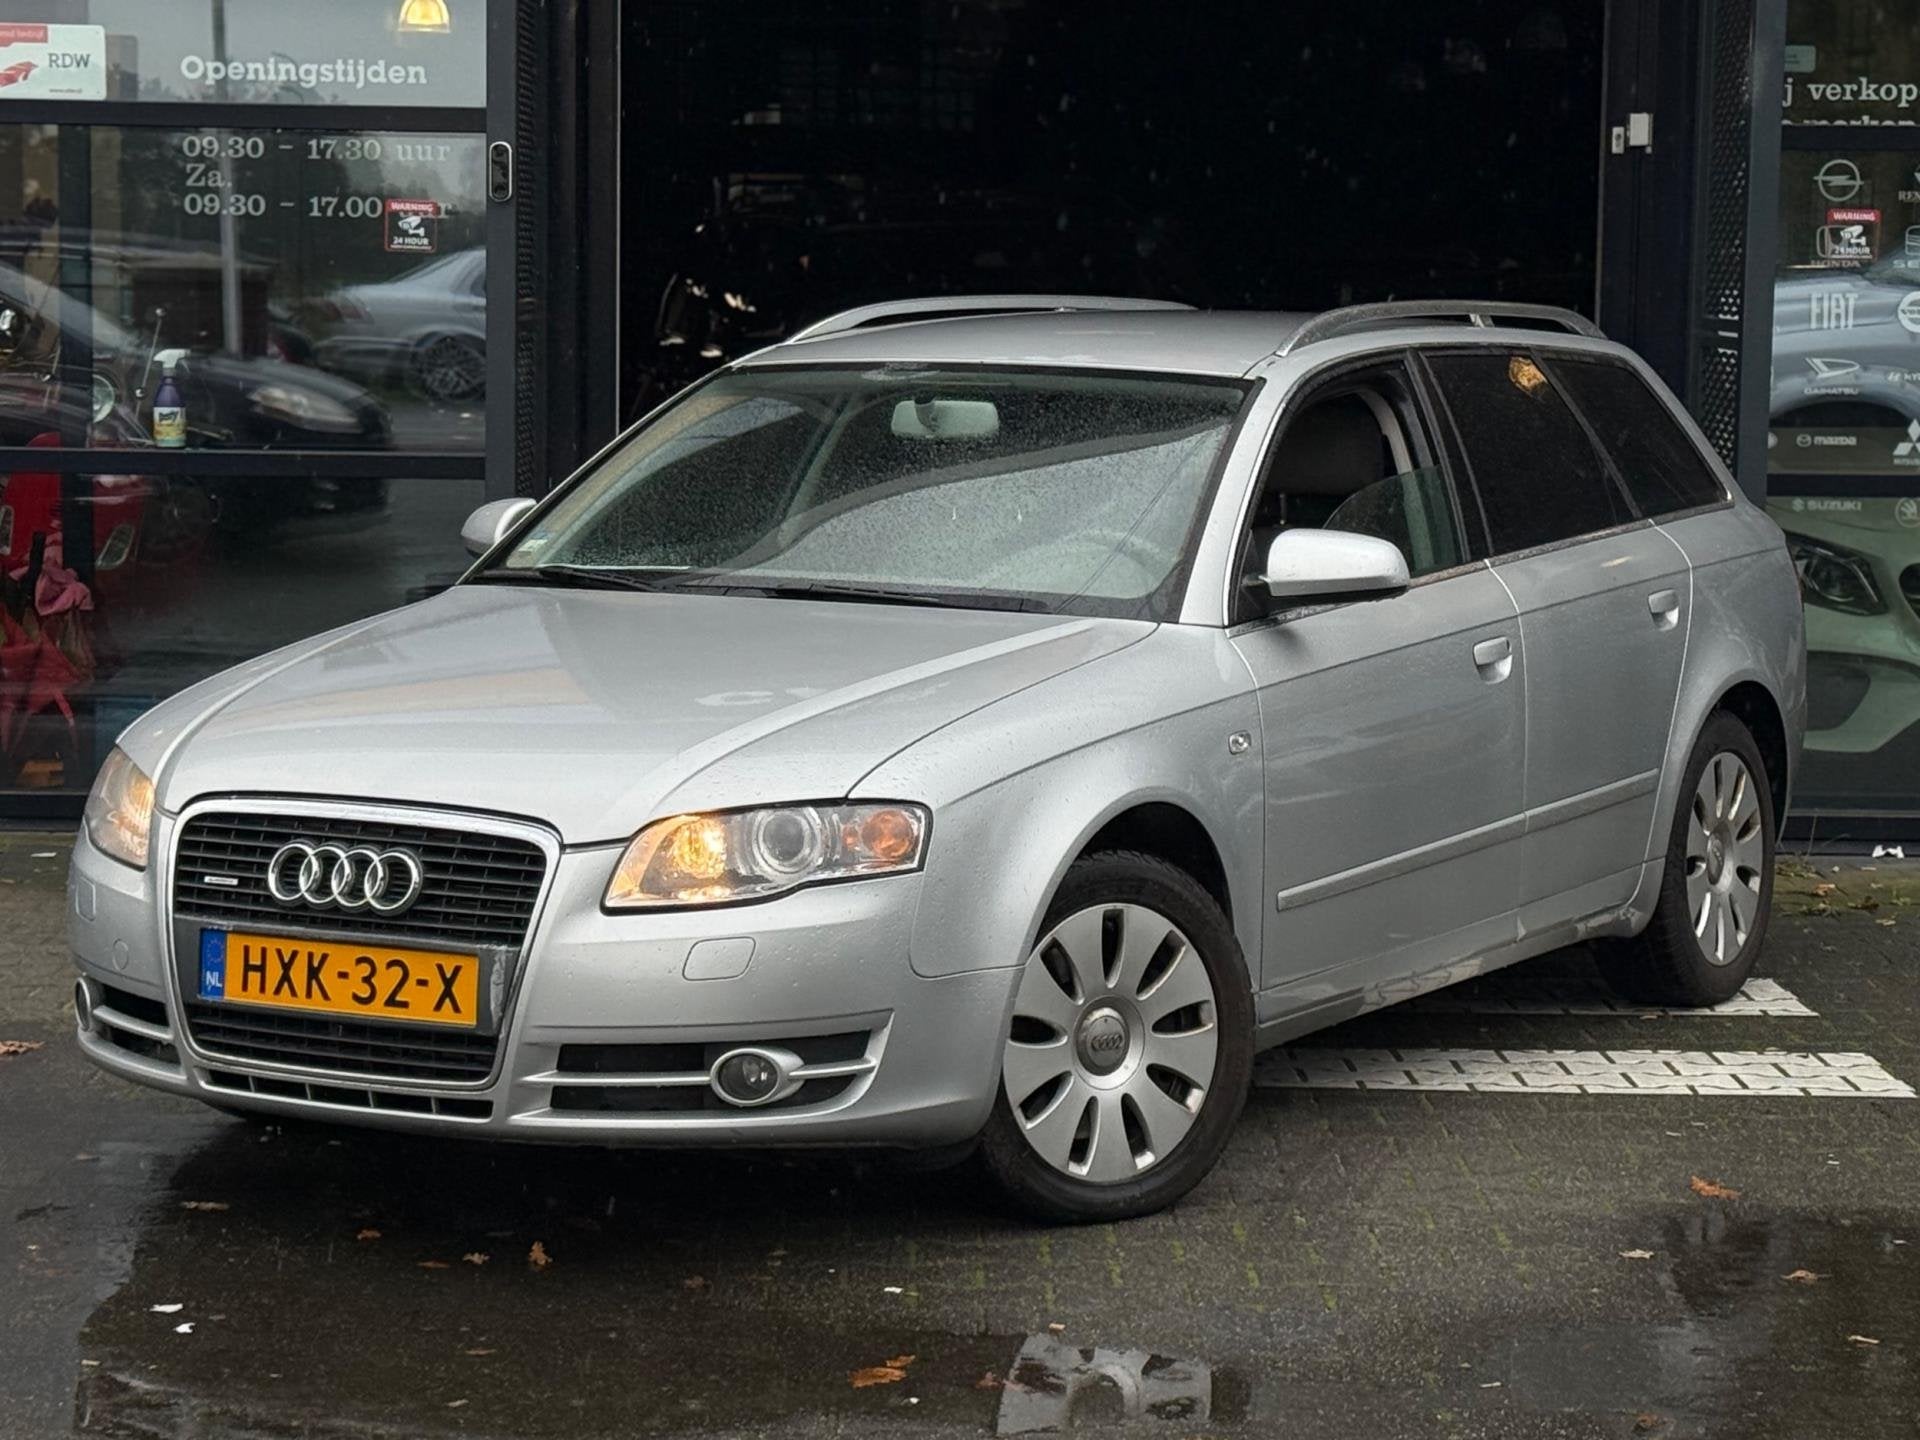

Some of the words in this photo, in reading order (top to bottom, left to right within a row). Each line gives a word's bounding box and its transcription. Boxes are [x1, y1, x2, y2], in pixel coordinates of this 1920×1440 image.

[48, 52, 91, 69] RDW
[180, 55, 428, 88] Openingstijden
[1806, 76, 1920, 108] verkop
[182, 135, 265, 159] 09.30
[307, 139, 381, 160] 17.30
[396, 144, 451, 161] uur
[183, 163, 233, 187] Za.
[183, 193, 266, 217] 09.30
[309, 197, 383, 218] 17.00
[391, 202, 434, 212] WARNING
[1833, 211, 1876, 222] WARNING
[405, 237, 429, 245] HOUR
[1893, 260, 1920, 269] SE
[1810, 292, 1859, 330] FIAT
[1813, 436, 1857, 446] mazda
[206, 970, 223, 988] NL
[241, 944, 463, 1014] HXK-32-X
